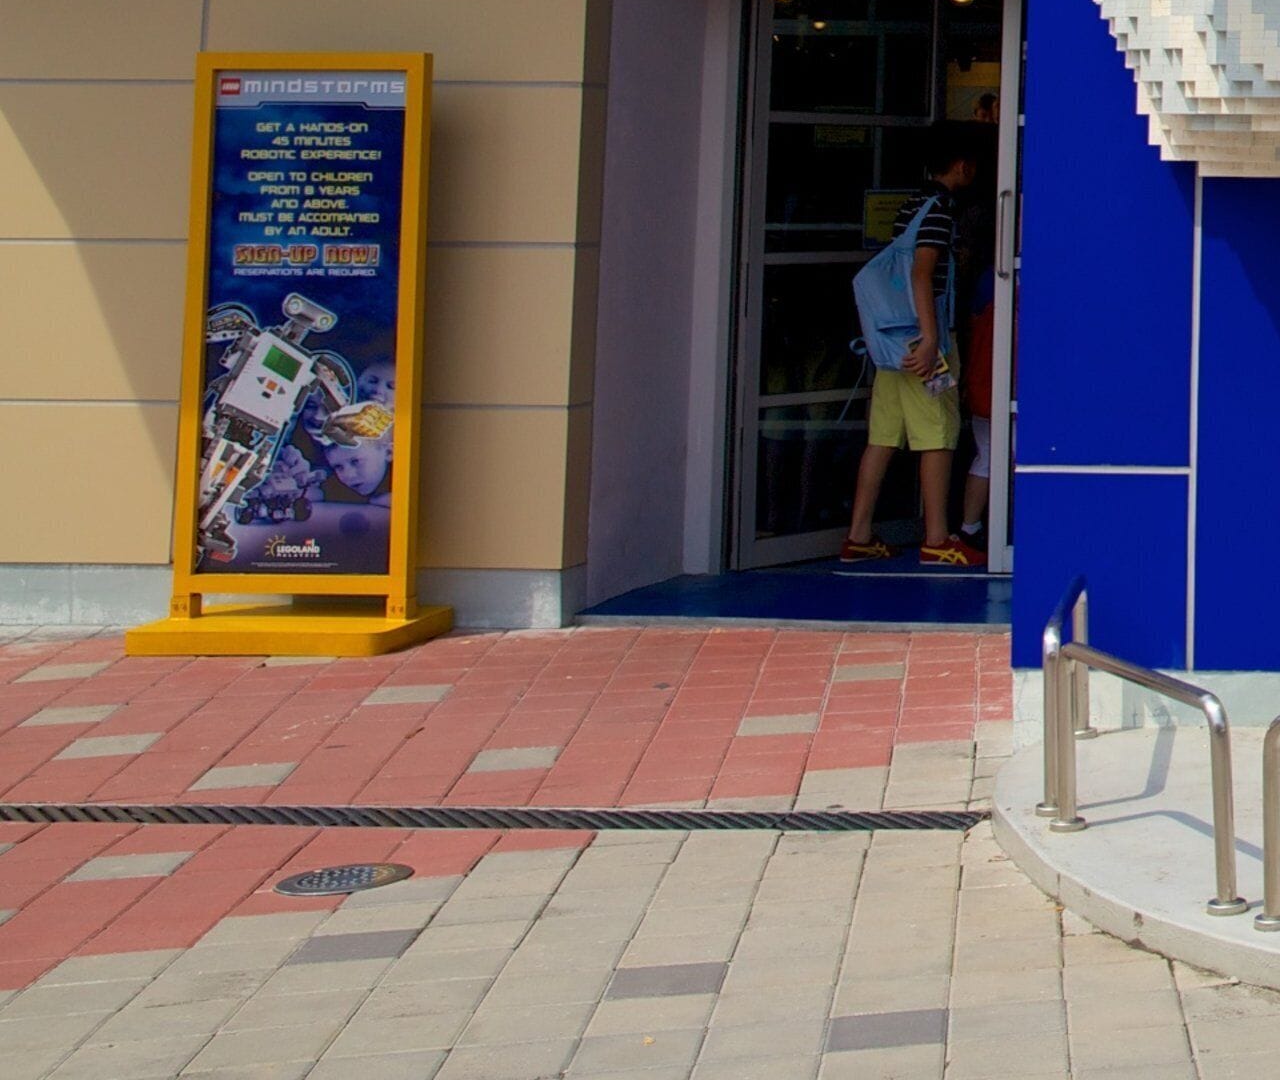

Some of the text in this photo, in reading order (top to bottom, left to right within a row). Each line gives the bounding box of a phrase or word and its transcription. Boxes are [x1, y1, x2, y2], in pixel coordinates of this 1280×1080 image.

[256, 122, 368, 132] GET A HANDS-ON
[272, 136, 351, 146] 45 MINUTES
[241, 150, 382, 160] ROBOTIC EXPERIENCE!
[248, 172, 373, 182] OPEN TO CHILDREN
[260, 185, 300, 195] FROM
[319, 186, 360, 195] YEARS
[271, 199, 349, 209] AND ABOVE.
[239, 212, 379, 223] MUST BE ACCOMPANIED
[264, 226, 353, 236] BY AN ADULT.
[234, 245, 317, 265] SIGN-UP
[233, 268, 303, 277] RESERVATIONS
[306, 268, 325, 277] ARE
